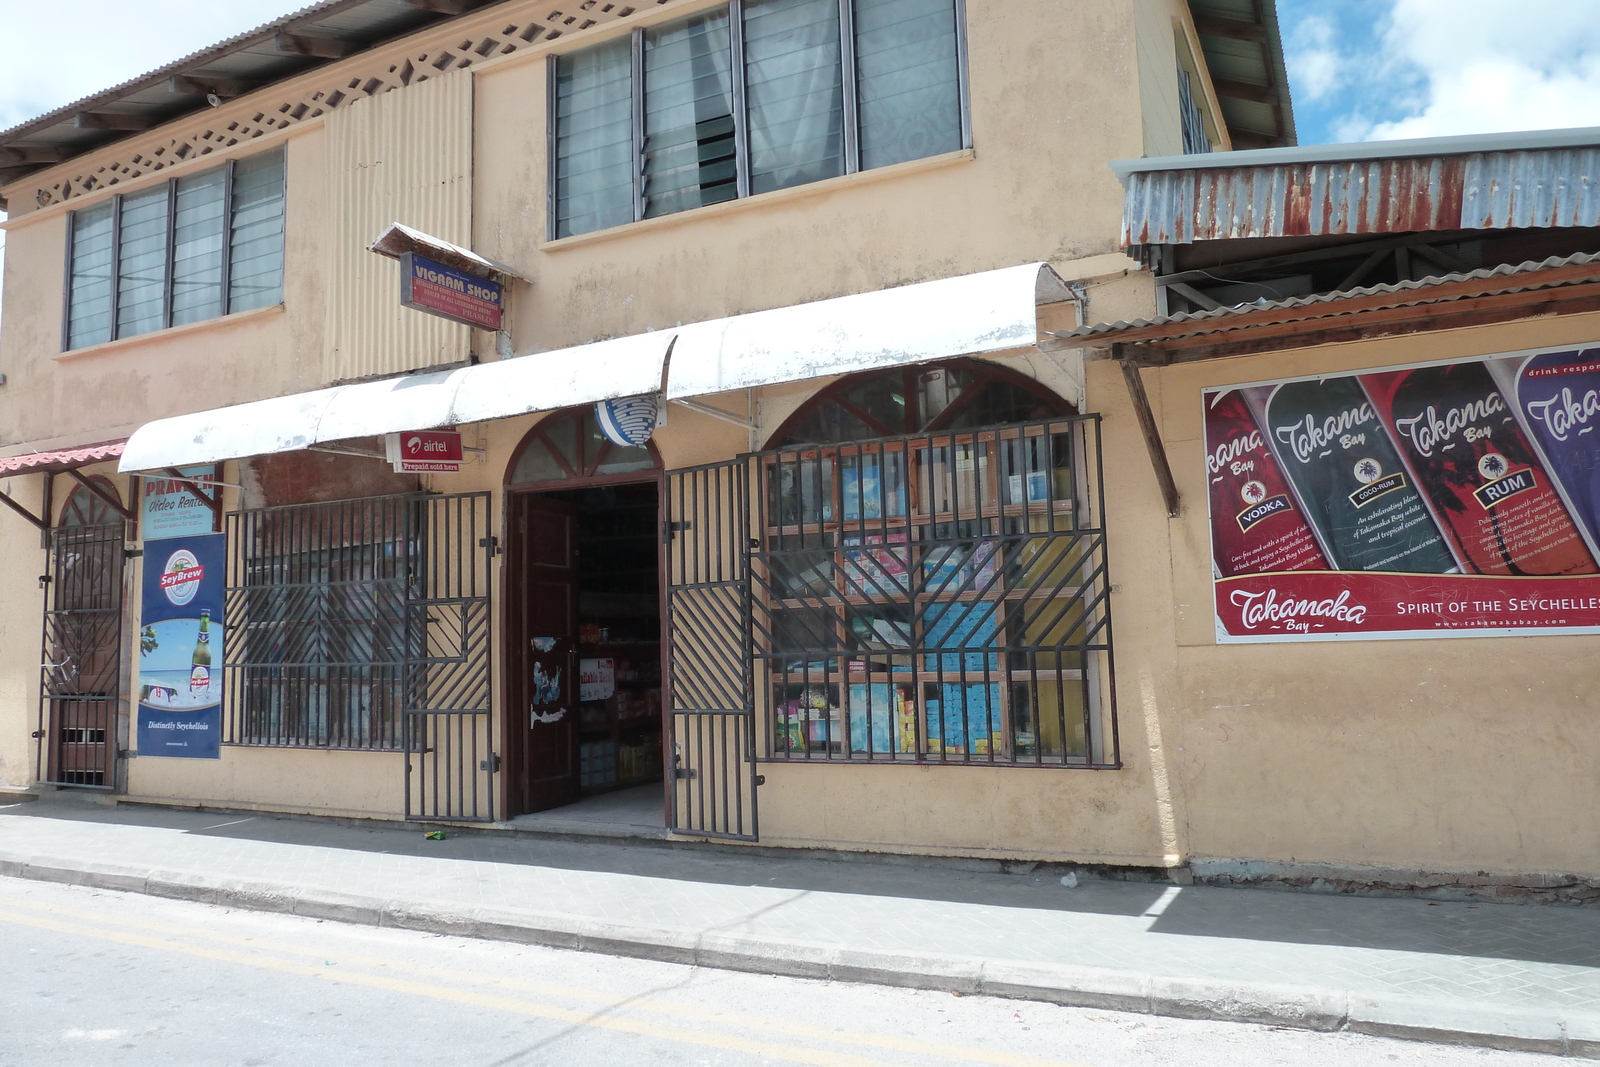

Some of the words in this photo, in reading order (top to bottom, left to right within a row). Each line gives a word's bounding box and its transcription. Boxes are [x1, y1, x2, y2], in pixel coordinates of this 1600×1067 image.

[415, 265, 465, 293] VIGRAM
[467, 283, 498, 302] SHOP
[462, 308, 494, 324] PRASLIN
[1528, 367, 1558, 377] drink
[1339, 432, 1366, 450] Bay
[1463, 425, 1492, 443] Bay
[424, 440, 448, 452] airtel
[403, 463, 428, 471] Prepaid
[1230, 460, 1255, 476] Bay
[1358, 479, 1395, 500] COCO-RUM
[1484, 474, 1526, 501] RUM
[149, 497, 176, 512] Video
[178, 493, 210, 509] Renta
[1242, 500, 1285, 522] VODKA
[1358, 517, 1367, 526] An
[1367, 500, 1403, 520] exhilarating
[1510, 499, 1532, 514] smooth
[1532, 492, 1544, 504] and
[1353, 529, 1360, 540] of
[1360, 518, 1391, 536] Takamaka
[1390, 512, 1404, 523] Bay
[1404, 504, 1420, 516] white
[1368, 532, 1380, 544] and
[1380, 522, 1404, 538] tropical
[1404, 513, 1428, 528] coconut.
[1482, 520, 1507, 534] lingering
[1508, 514, 1524, 524] notes
[1524, 509, 1530, 518] of
[1530, 501, 1550, 514] vanilla
[1502, 518, 1534, 535] Takamaka
[1534, 512, 1548, 522] Bay
[1548, 504, 1562, 516] dark
[1232, 550, 1252, 563] Care-free
[1252, 544, 1262, 554] and
[1262, 540, 1276, 550] with
[1280, 531, 1294, 542] spirit
[1294, 527, 1300, 536] of
[1300, 524, 1308, 532] ad
[1484, 541, 1502, 552] reflects
[1502, 537, 1512, 546] the
[1513, 527, 1538, 541] heritage
[1538, 520, 1550, 530] and
[1490, 550, 1496, 560] of
[1496, 546, 1510, 558] spirit
[1512, 543, 1518, 552] of
[1518, 540, 1528, 548] the
[1528, 526, 1559, 544] Seychelles
[1250, 556, 1260, 566] and
[1260, 552, 1275, 562] enjoy
[1278, 538, 1304, 553] Seychelles
[1258, 557, 1286, 572] Takamaka
[1286, 552, 1298, 561] Bay
[1298, 543, 1314, 555] Vodka
[161, 569, 202, 586] SeyBrew
[1230, 588, 1366, 629] Takamaka
[1396, 601, 1444, 615] SPIRIT
[1448, 601, 1468, 613] OF
[1473, 600, 1502, 612] THE
[1282, 618, 1310, 634] Bay
[1434, 618, 1566, 628] www.takamakabay.com
[148, 720, 176, 730] Distinctly
[176, 721, 209, 731] Seychellois
